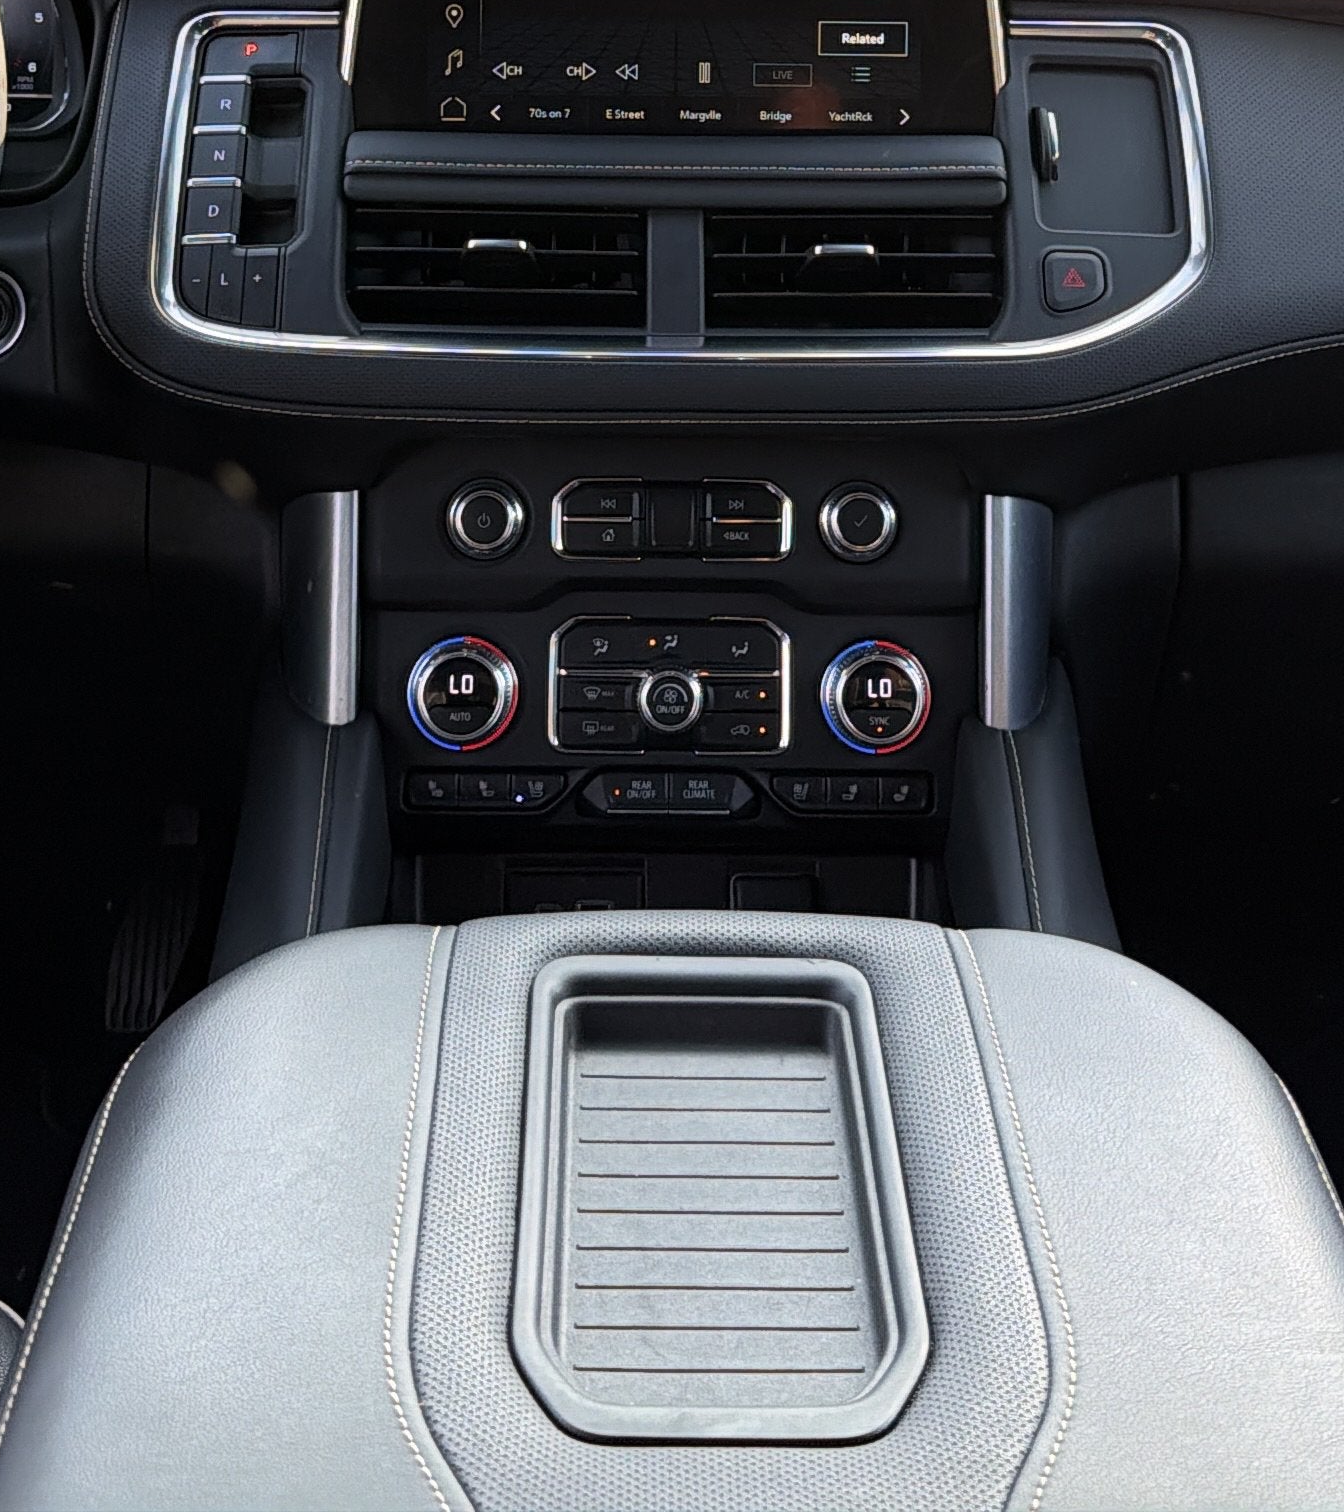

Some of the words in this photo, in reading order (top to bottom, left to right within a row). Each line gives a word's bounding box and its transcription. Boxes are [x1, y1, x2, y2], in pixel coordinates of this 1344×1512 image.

[34, 12, 44, 23] 5
[841, 32, 884, 45] Related
[244, 42, 257, 57] P
[27, 62, 37, 73] 6
[506, 65, 522, 76] CH
[566, 65, 582, 77] CH
[772, 69, 793, 81] LIVE
[220, 98, 232, 111] R
[529, 107, 547, 119] 70s
[550, 110, 562, 119] on
[564, 108, 570, 119] 7
[606, 109, 612, 119] E
[613, 108, 645, 120] Street
[759, 109, 792, 123] Bridge
[828, 110, 873, 123] YachtRck
[213, 149, 225, 162] N
[208, 204, 220, 218] D
[220, 272, 229, 285] L
[729, 531, 750, 541] BACK
[449, 673, 474, 694] LO
[867, 678, 891, 699] LO
[735, 690, 750, 699] A/C
[656, 705, 685, 714] ON/OFF
[449, 711, 471, 721] AUTO
[869, 715, 891, 726] SYNC
[631, 780, 652, 790] REAR
[688, 779, 709, 790] REAR
[626, 789, 657, 800] ON/OFF
[682, 789, 716, 800] CLIMATE
